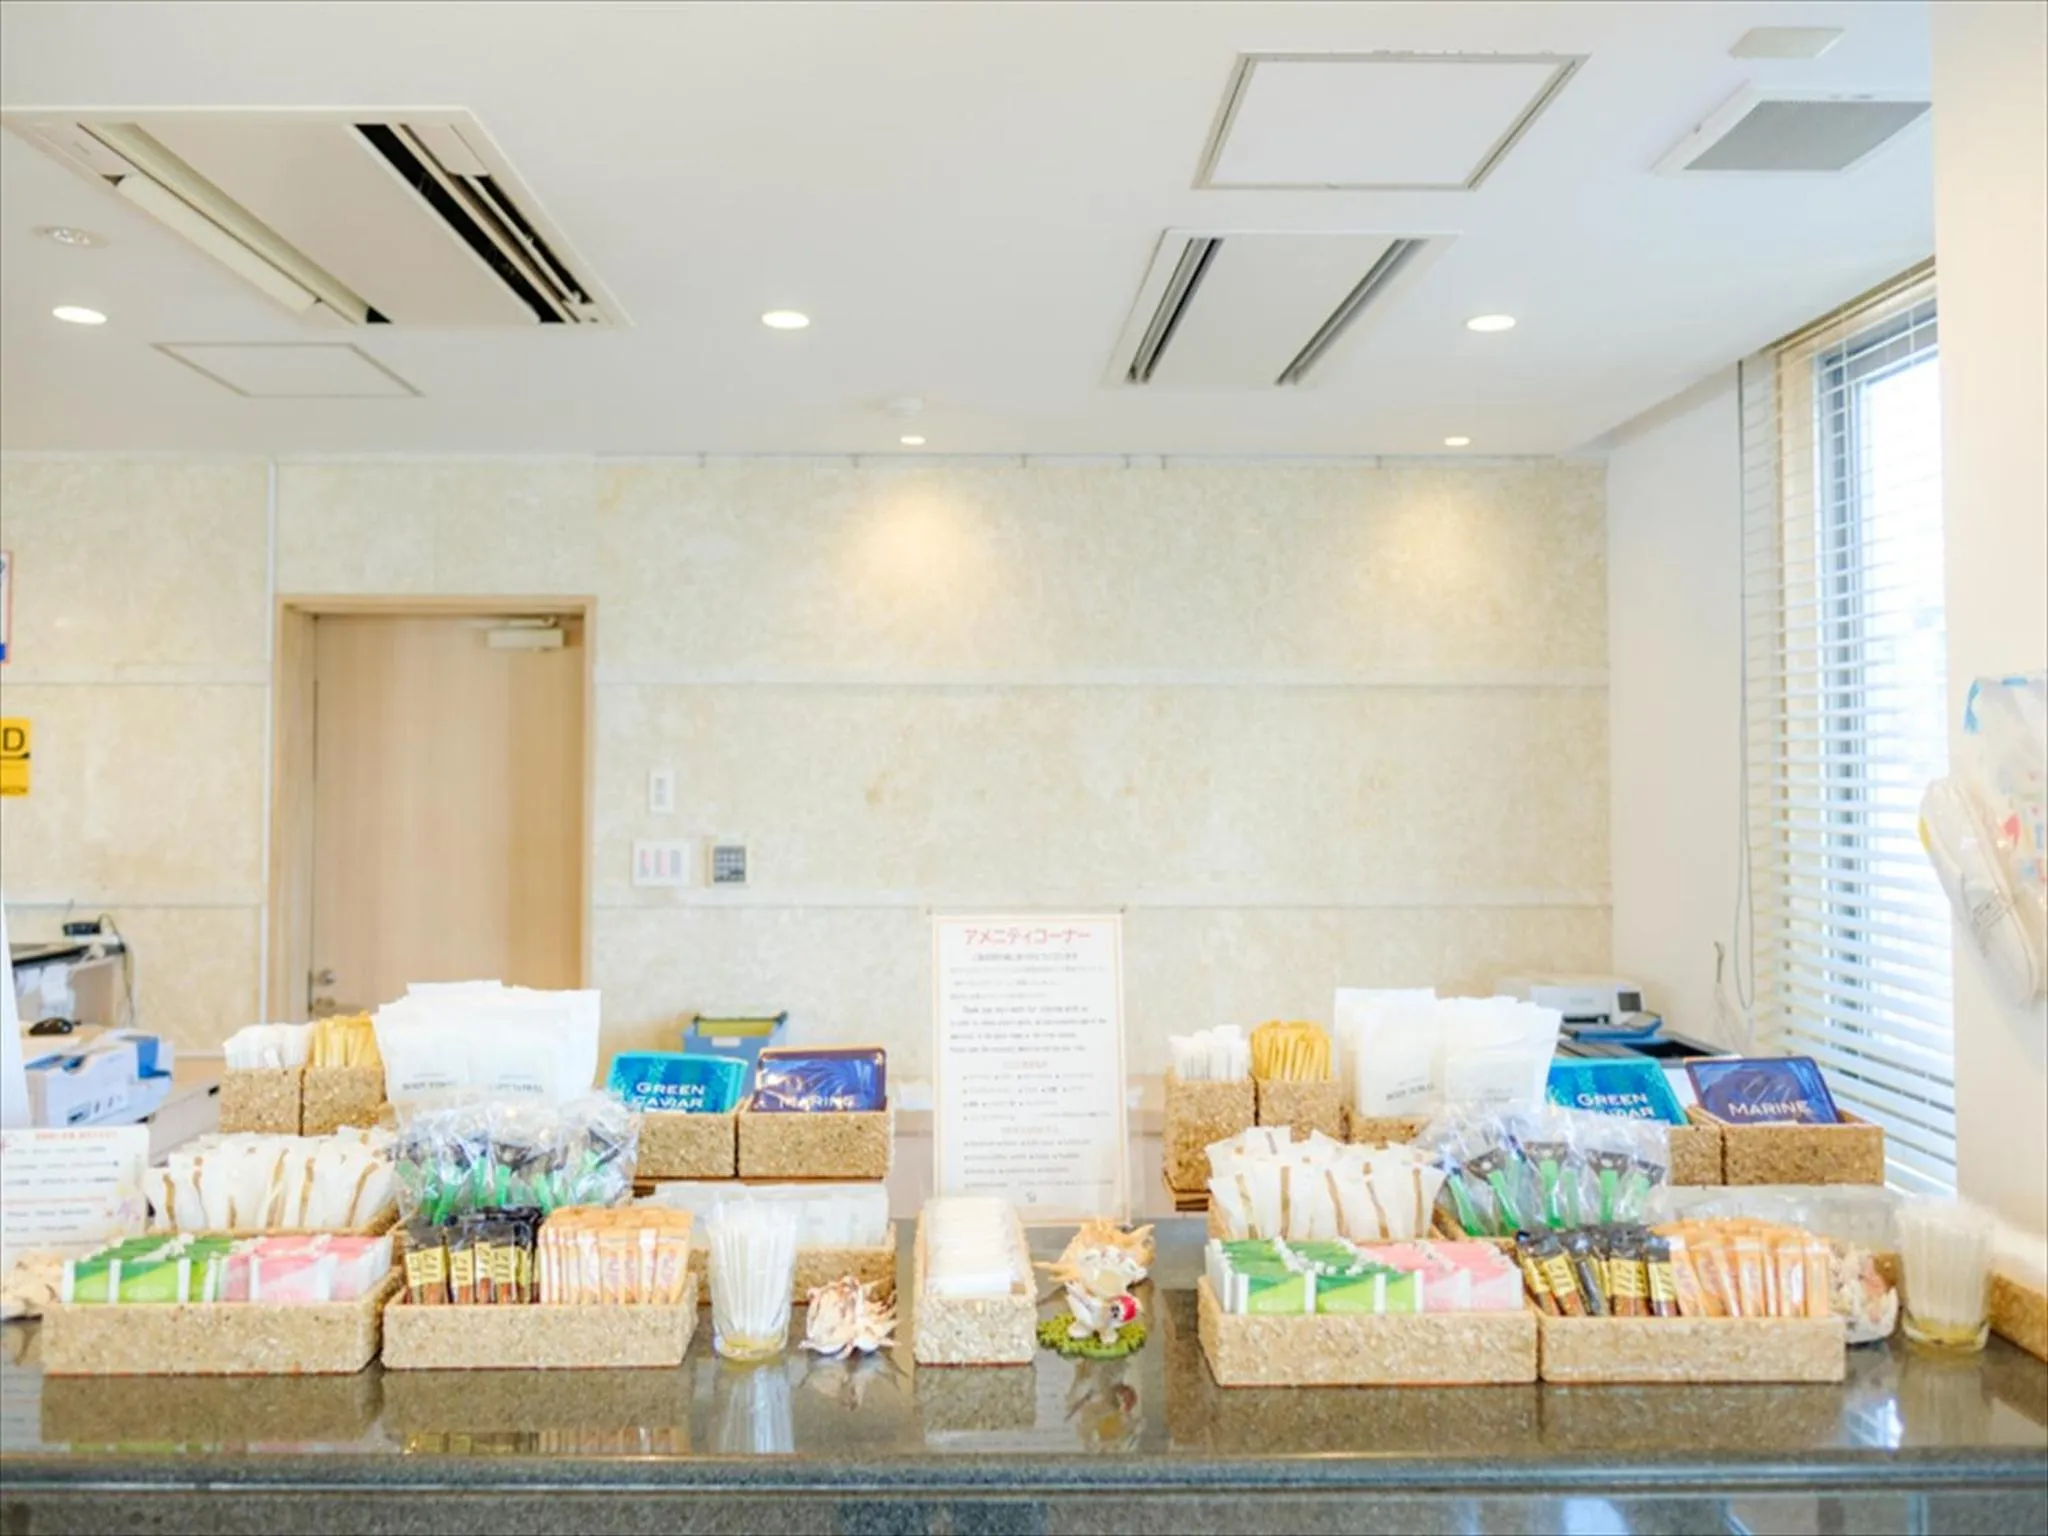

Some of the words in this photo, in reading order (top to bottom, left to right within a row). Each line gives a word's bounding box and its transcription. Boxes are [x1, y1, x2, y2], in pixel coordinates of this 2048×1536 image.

[965, 927, 1092, 946] アメニティコーナー
[636, 1081, 705, 1096] GREEN
[1576, 1092, 1648, 1107] GREEN
[1729, 1101, 1812, 1118] MARINE
